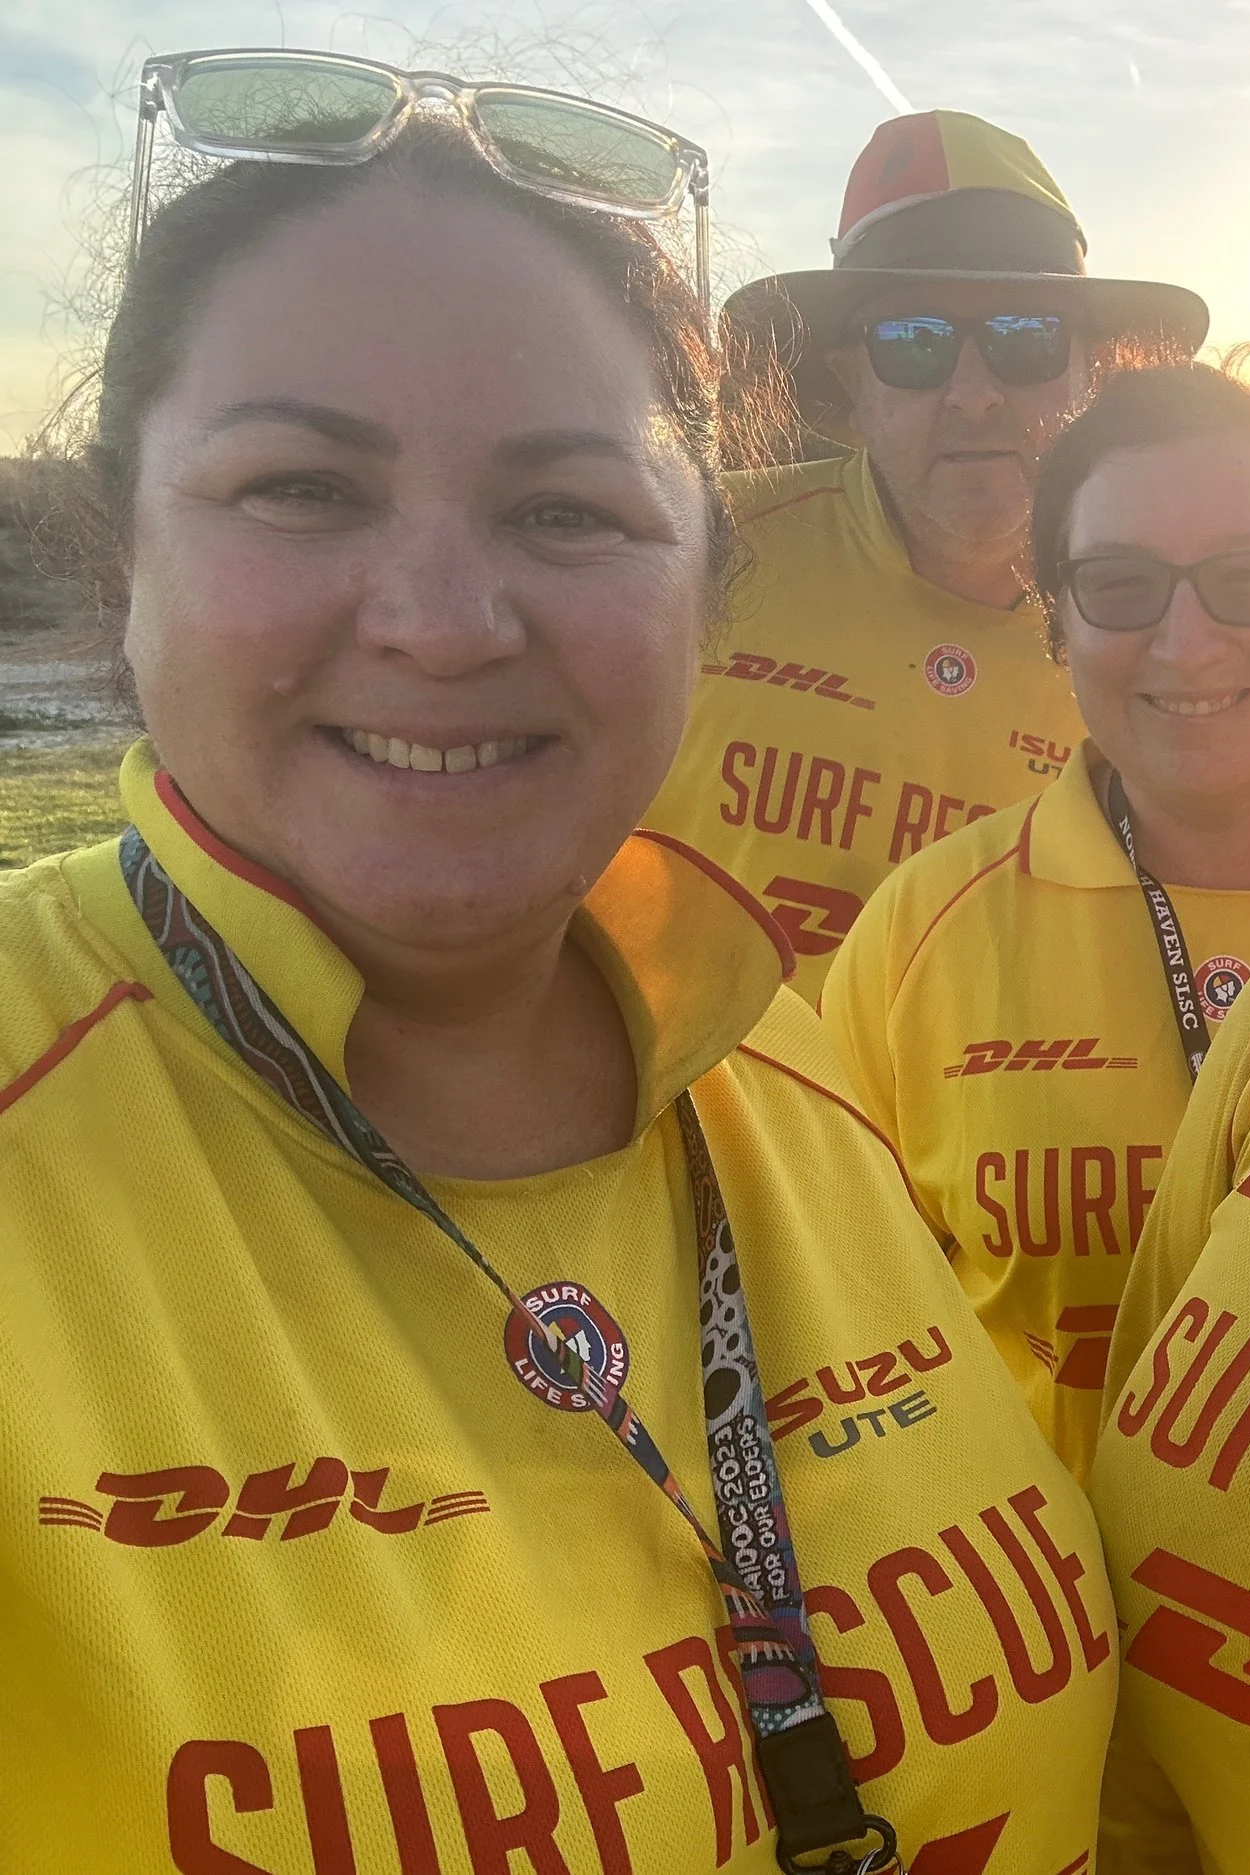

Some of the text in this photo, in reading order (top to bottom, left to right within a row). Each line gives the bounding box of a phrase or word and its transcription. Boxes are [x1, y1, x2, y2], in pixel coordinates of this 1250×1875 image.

[723, 652, 856, 703] DHL
[1009, 730, 1071, 763] ISU
[1028, 758, 1063, 780] UT
[720, 741, 881, 850] SURF
[1148, 889, 1185, 967] HAVEN
[1172, 972, 1199, 1030] SLSC
[1207, 959, 1242, 971] SURF
[1198, 991, 1214, 1015] IFE
[961, 1038, 1109, 1077] DHL
[975, 1145, 1163, 1258] SURF
[524, 1286, 592, 1313] SURF
[515, 1343, 625, 1407] LIFE SING
[765, 1325, 952, 1443] SUZU
[808, 1390, 937, 1459] UTE
[714, 1425, 744, 1498] 2023
[95, 1457, 425, 1547] DHL
[737, 1416, 790, 1601] FOR OUR ELDERS
